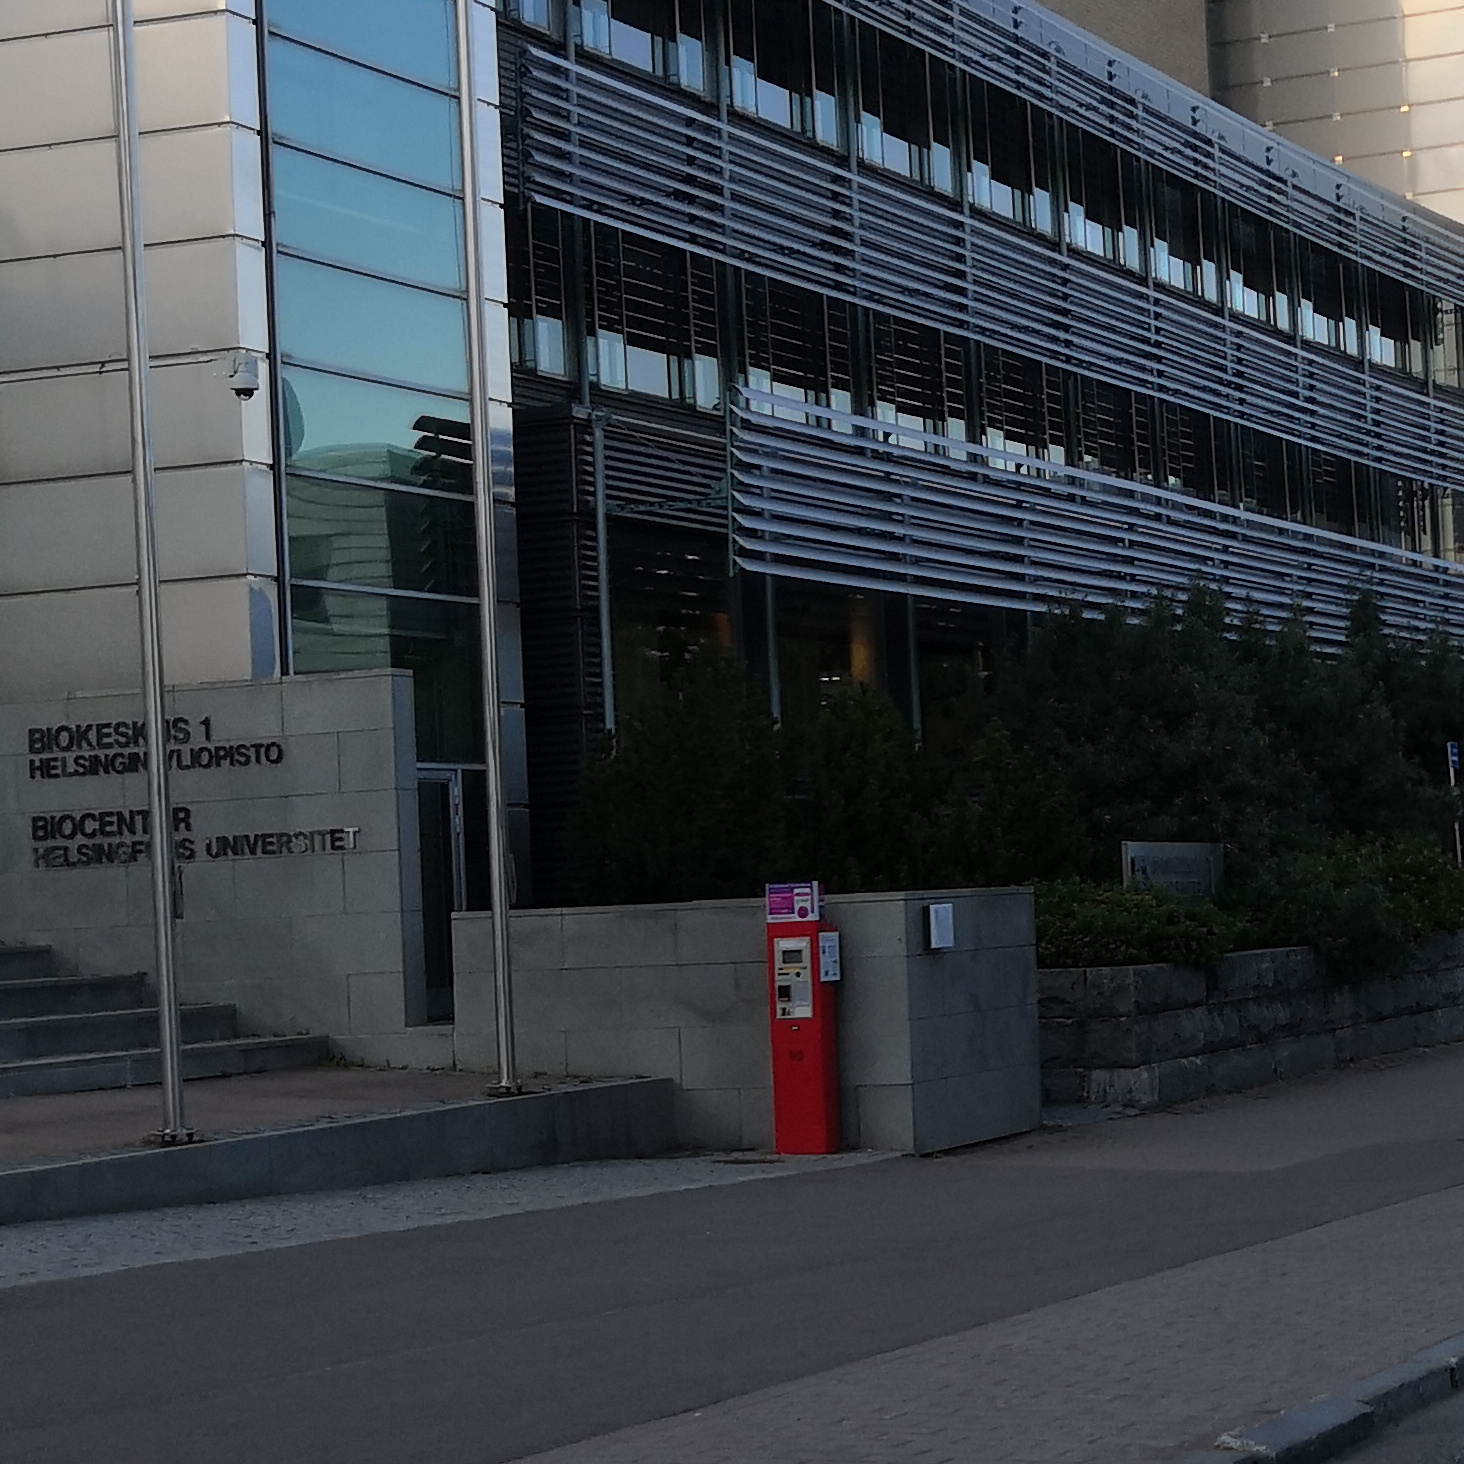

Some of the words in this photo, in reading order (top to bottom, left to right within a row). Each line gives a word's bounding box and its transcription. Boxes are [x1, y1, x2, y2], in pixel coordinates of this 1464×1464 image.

[200, 717, 212, 742] 1
[29, 751, 148, 779] HELSINGIN
[32, 807, 191, 840] BIOCENTR
[33, 839, 196, 868] HELSINGFS
[206, 827, 360, 859] UNIVERSITET
